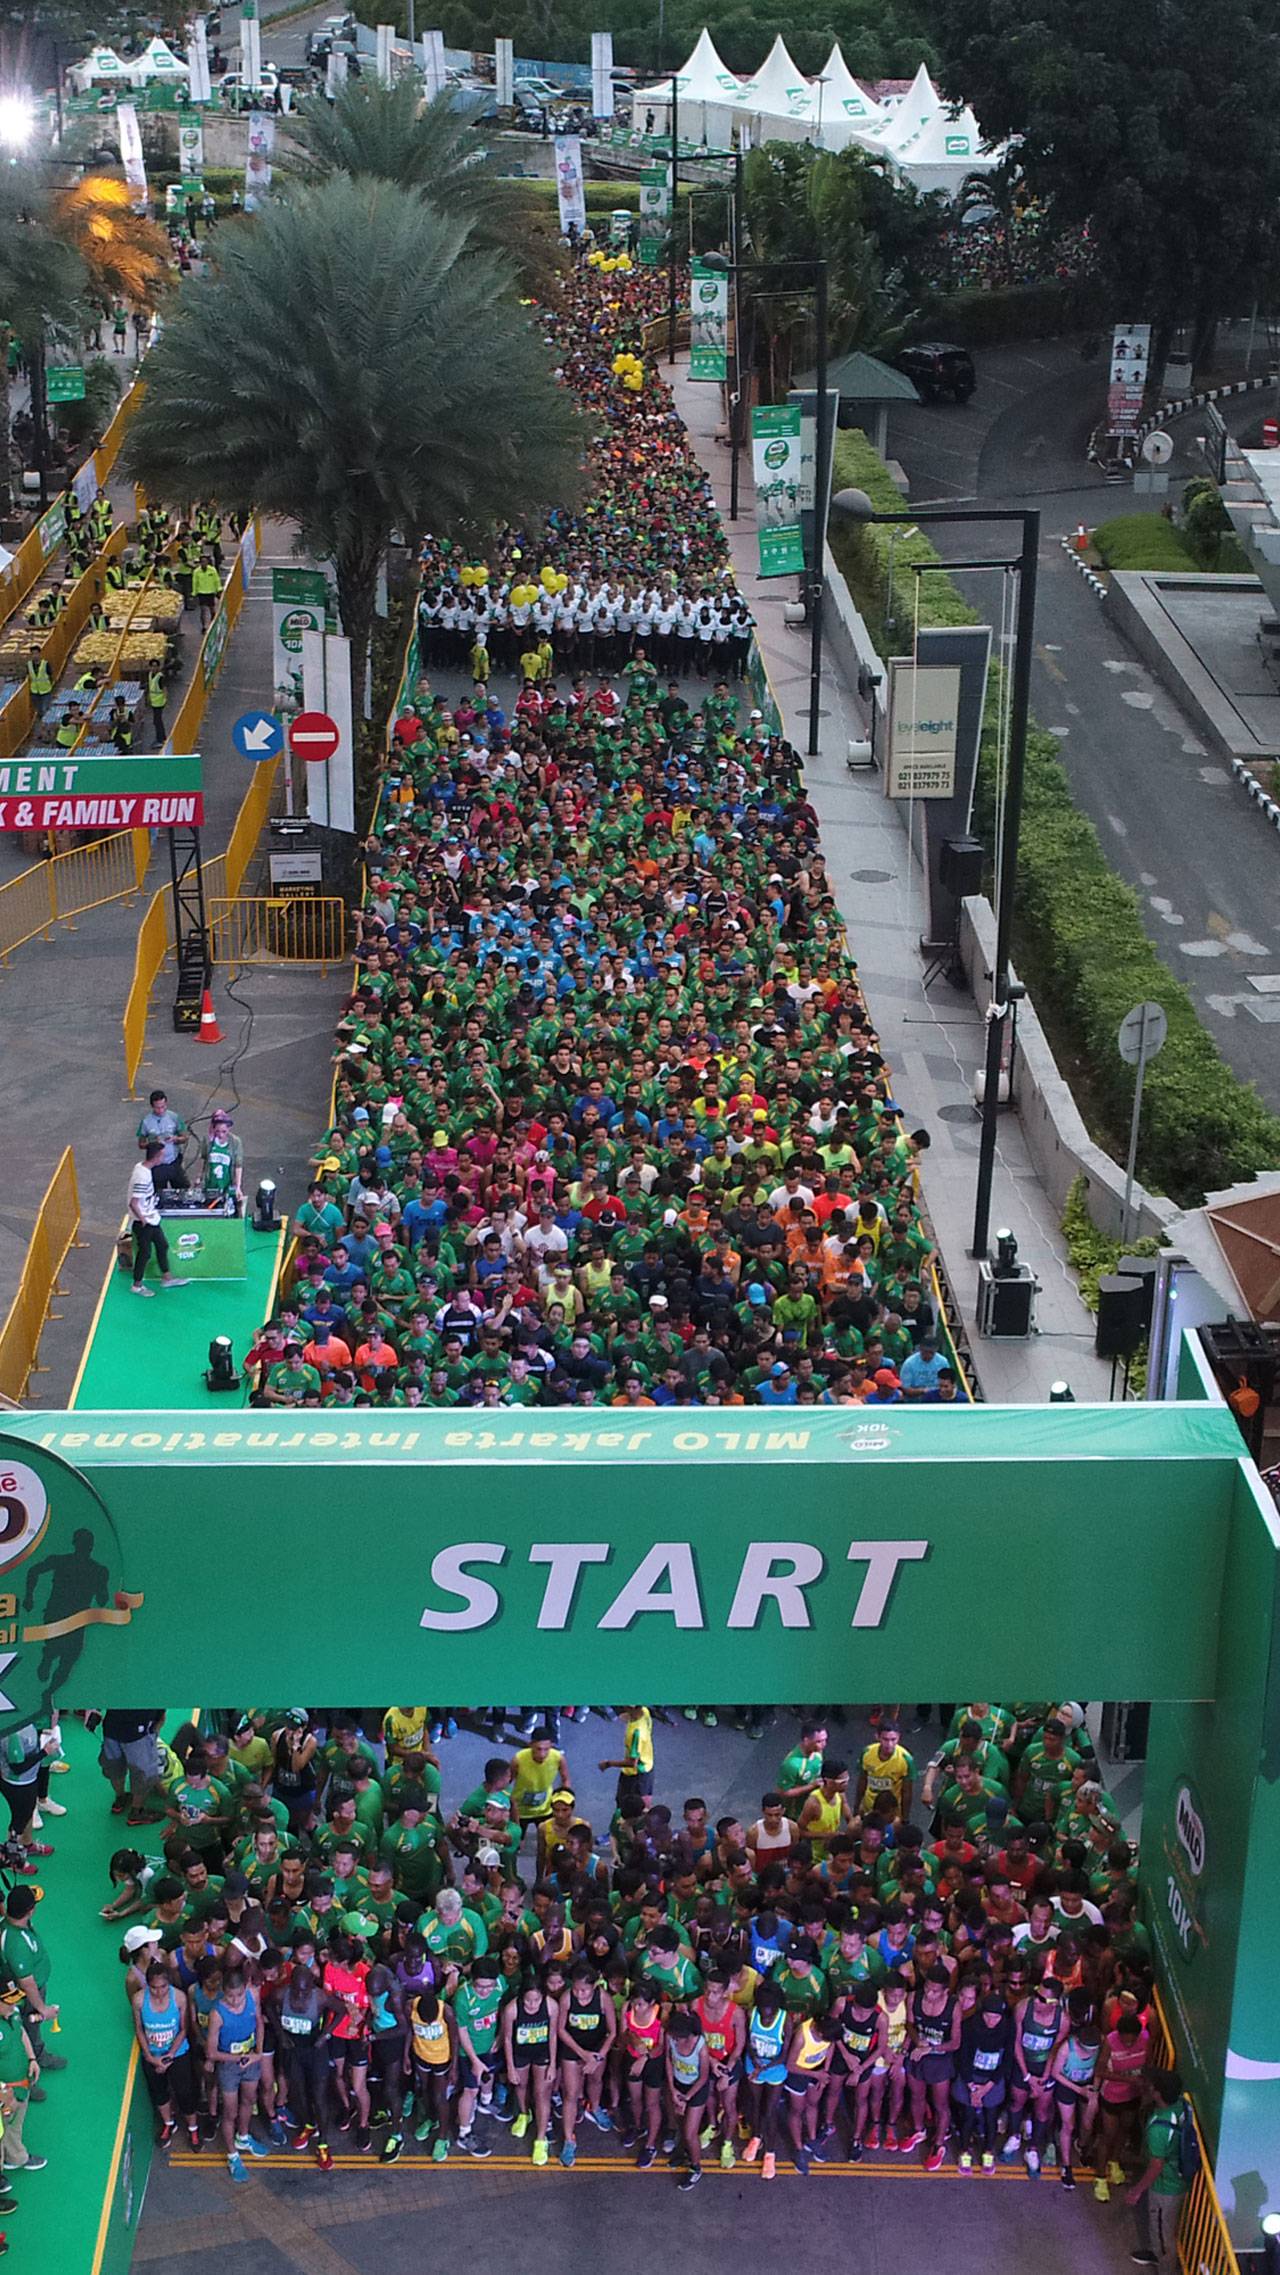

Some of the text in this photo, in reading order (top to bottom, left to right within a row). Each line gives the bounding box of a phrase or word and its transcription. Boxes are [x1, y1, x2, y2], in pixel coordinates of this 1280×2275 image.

[14, 801, 34, 828] &
[42, 798, 138, 826] FAMILY
[142, 797, 196, 824] RUN
[443, 1430, 652, 1452] Jakarta
[672, 1430, 810, 1451] MILO
[418, 1539, 929, 1632] START
[1178, 1799, 1202, 1867] MILO
[1167, 1875, 1192, 1949] 10K
